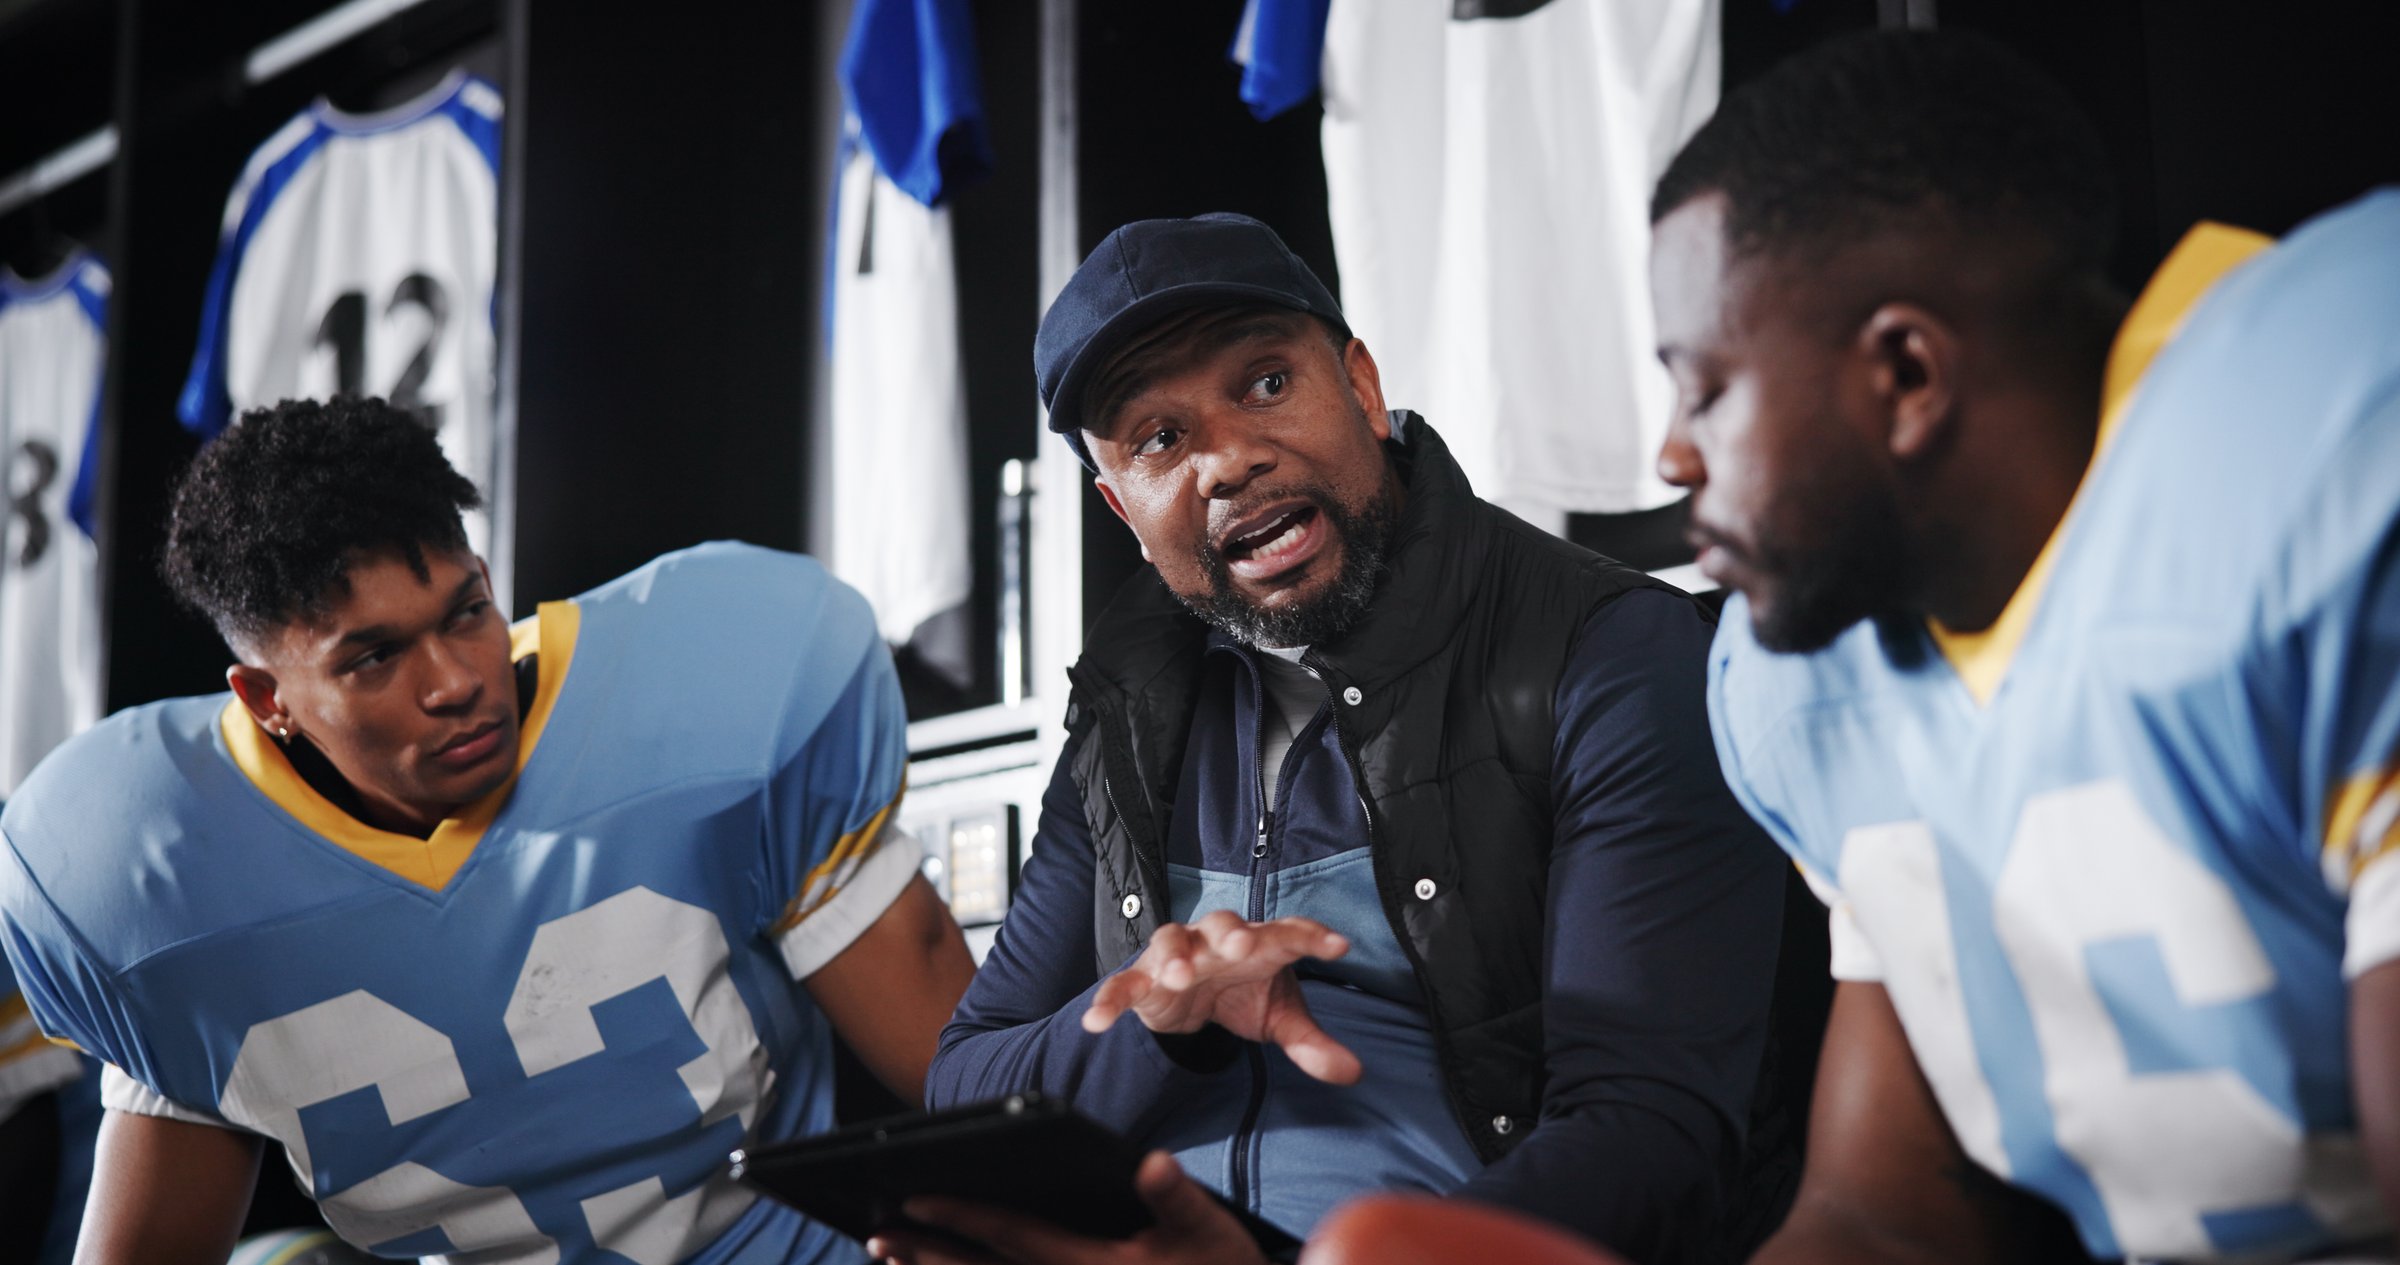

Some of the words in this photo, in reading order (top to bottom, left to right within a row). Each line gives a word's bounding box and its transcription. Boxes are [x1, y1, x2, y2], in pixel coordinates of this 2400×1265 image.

[314, 272, 448, 429] 12
[219, 885, 775, 1265] 63
[1838, 780, 2370, 1262] 16
